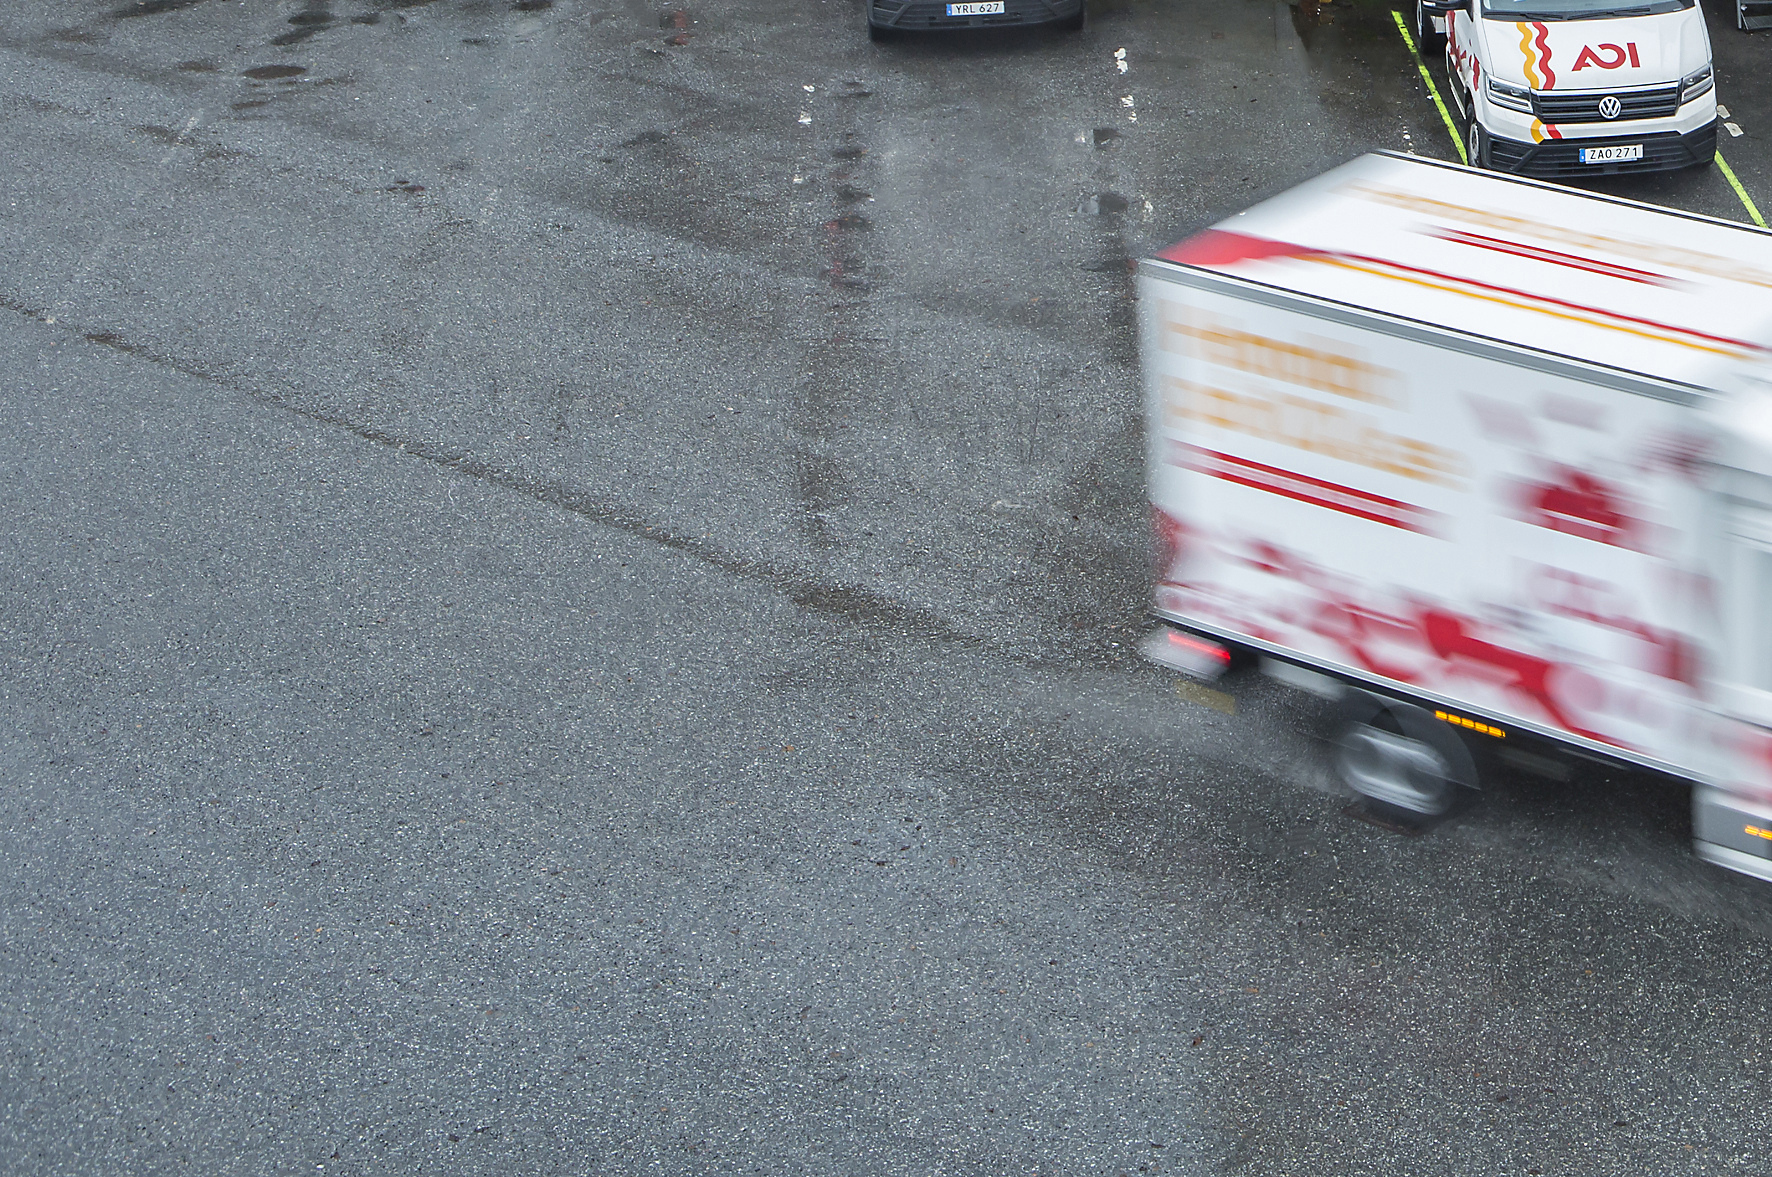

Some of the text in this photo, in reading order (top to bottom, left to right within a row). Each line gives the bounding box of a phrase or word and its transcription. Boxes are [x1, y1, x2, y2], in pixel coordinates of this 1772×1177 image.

[956, 3, 999, 14] YRL 627
[1590, 147, 1637, 160] ZAO 271
